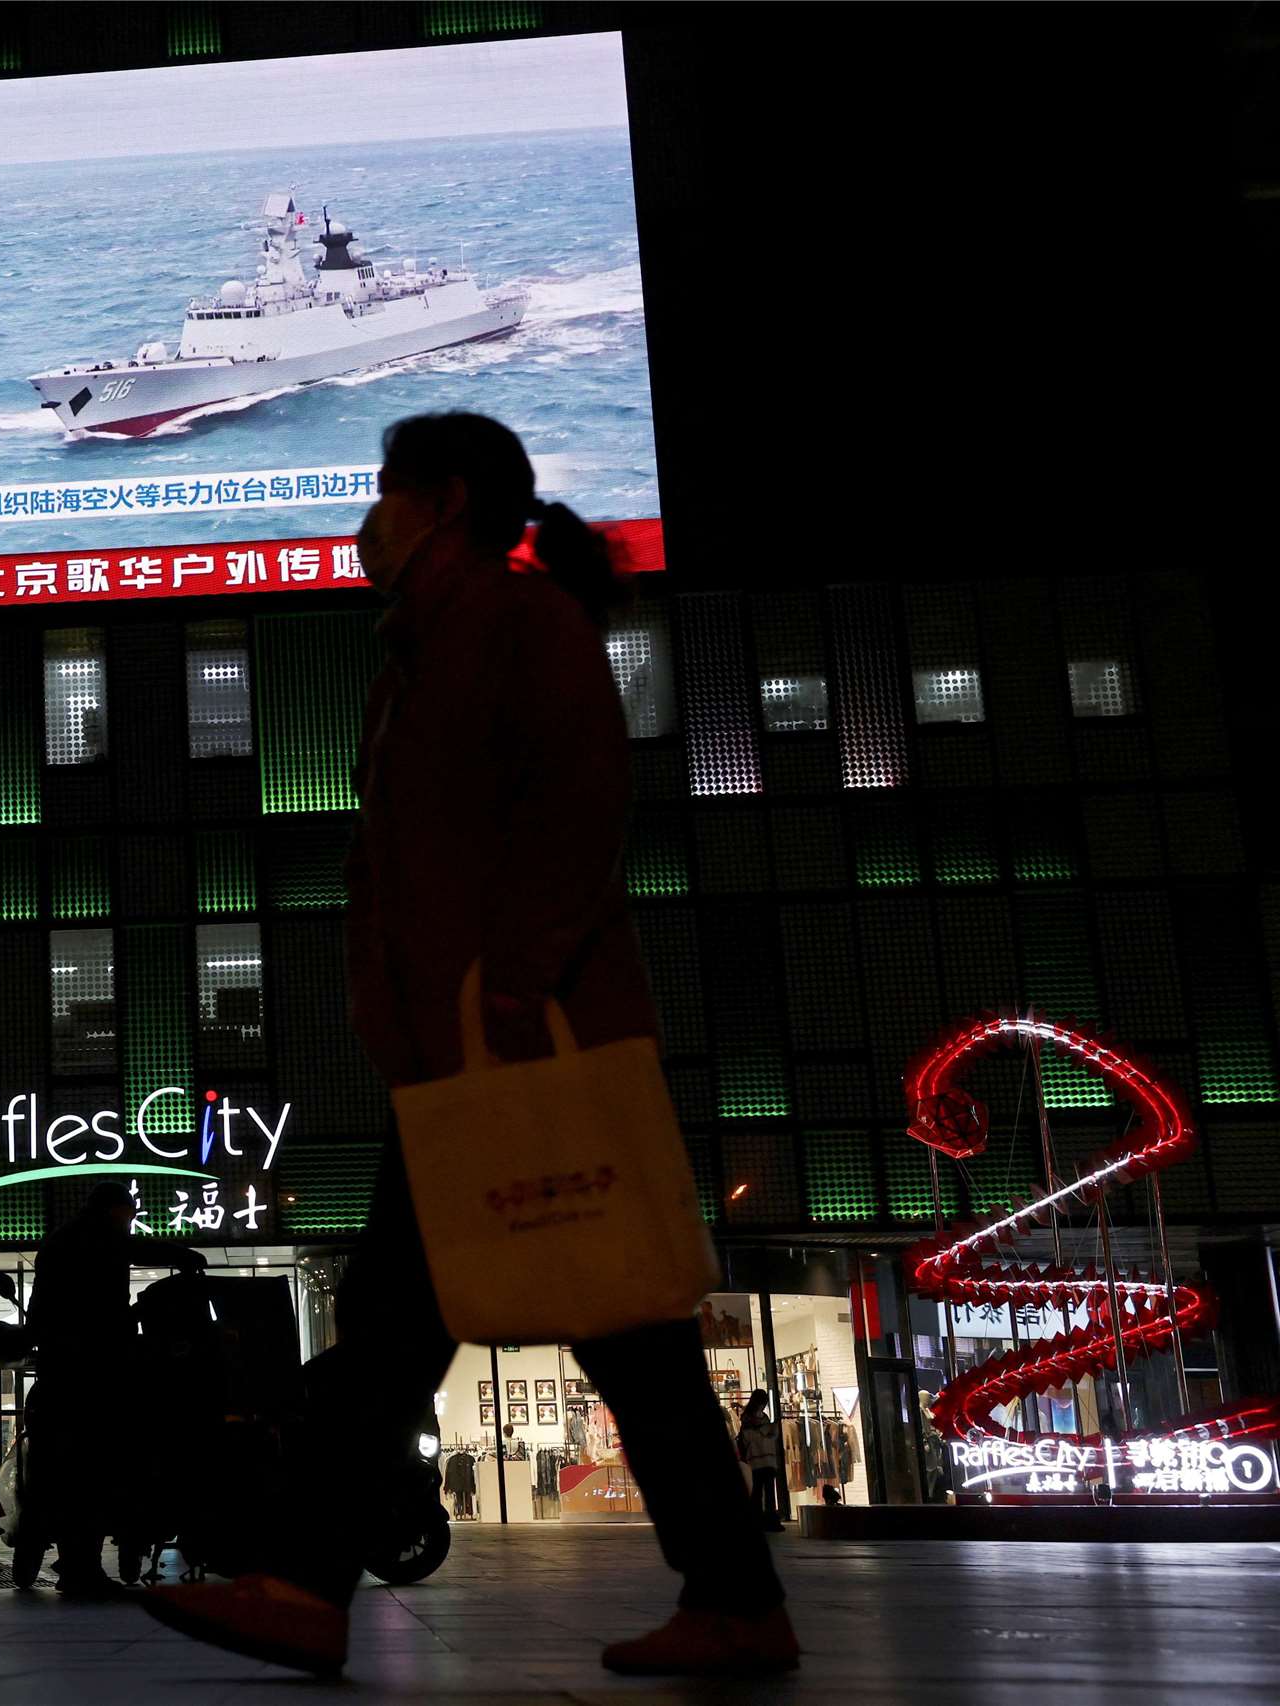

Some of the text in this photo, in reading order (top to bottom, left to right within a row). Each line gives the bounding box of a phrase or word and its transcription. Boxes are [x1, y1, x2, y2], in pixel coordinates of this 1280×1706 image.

[99, 378, 136, 402] 516
[137, 1087, 291, 1170] City
[951, 1440, 1034, 1467] Raffles
[1036, 1439, 1093, 1472] City
